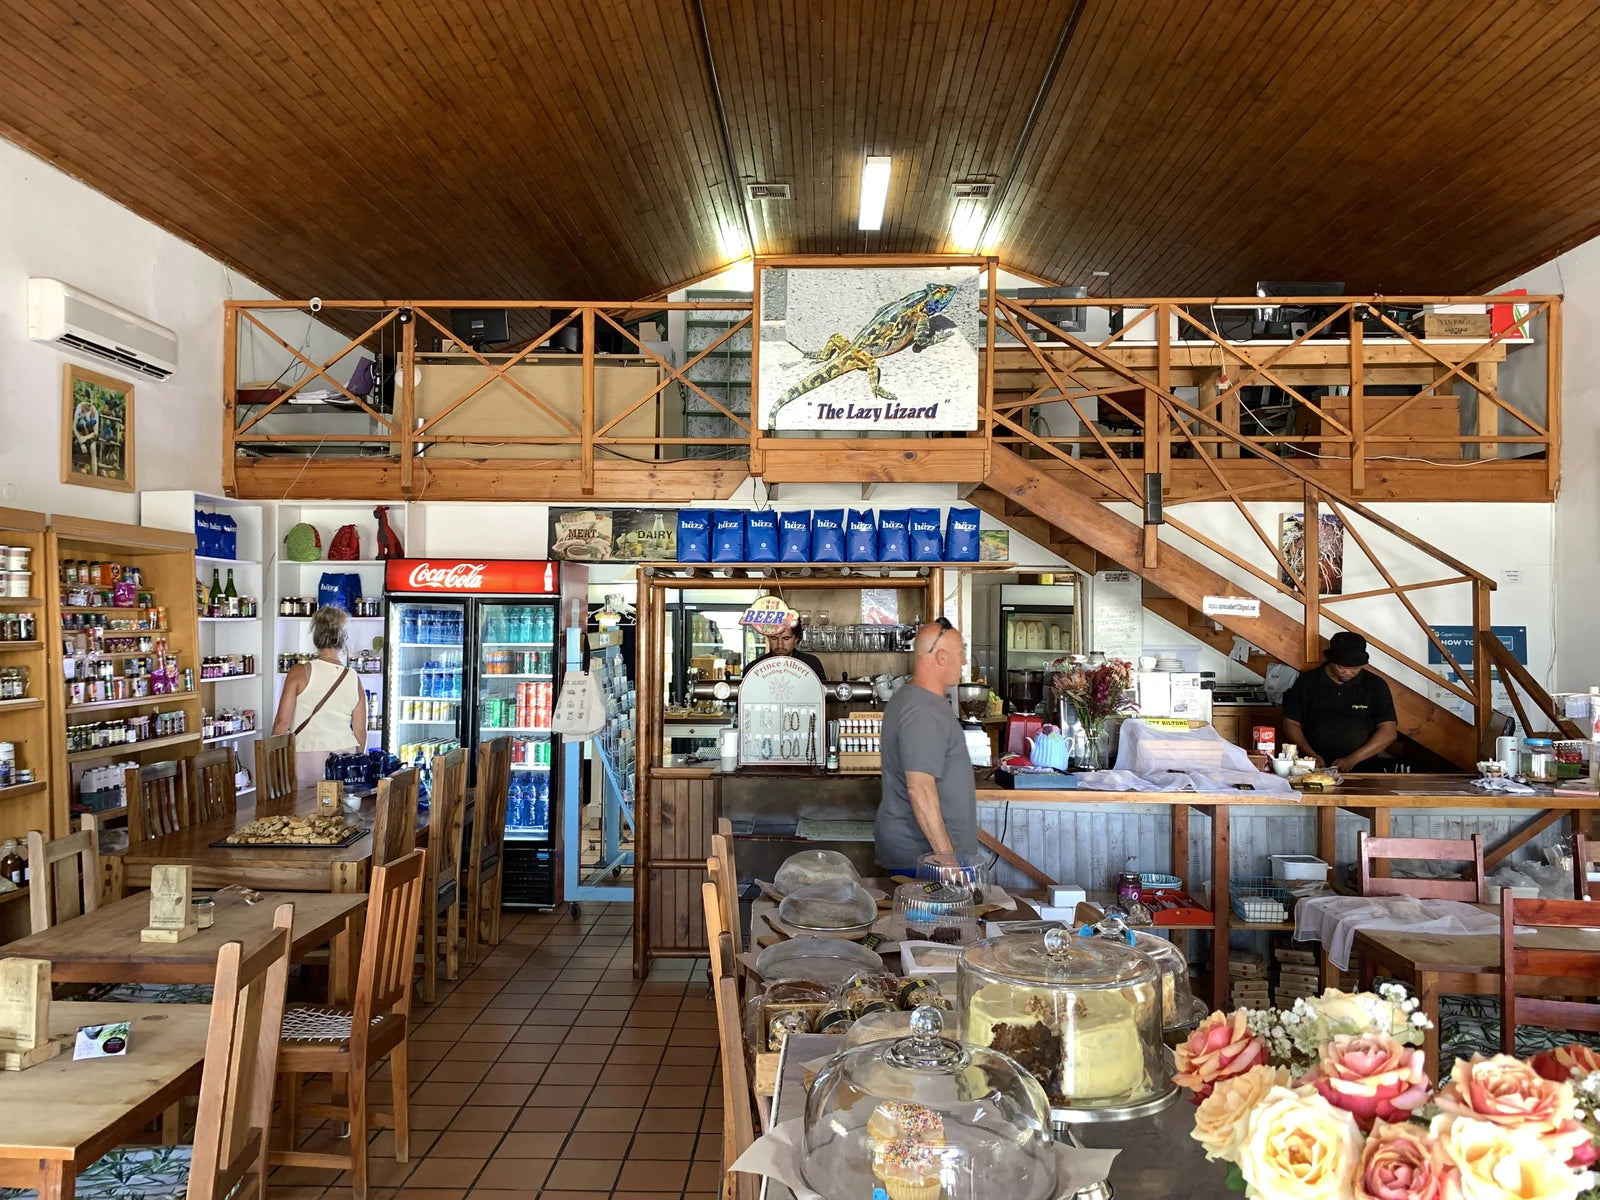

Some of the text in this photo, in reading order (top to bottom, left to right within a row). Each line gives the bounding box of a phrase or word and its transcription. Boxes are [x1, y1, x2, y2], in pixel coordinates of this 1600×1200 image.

[818, 402, 939, 422] The Lazy Lizard
[568, 528, 598, 538] MEAT
[637, 530, 673, 539] DAIRY
[408, 562, 488, 588] Coca-Cola
[743, 610, 785, 624] BEER
[753, 660, 810, 678] Prince Albert
[783, 668, 802, 680] Project
